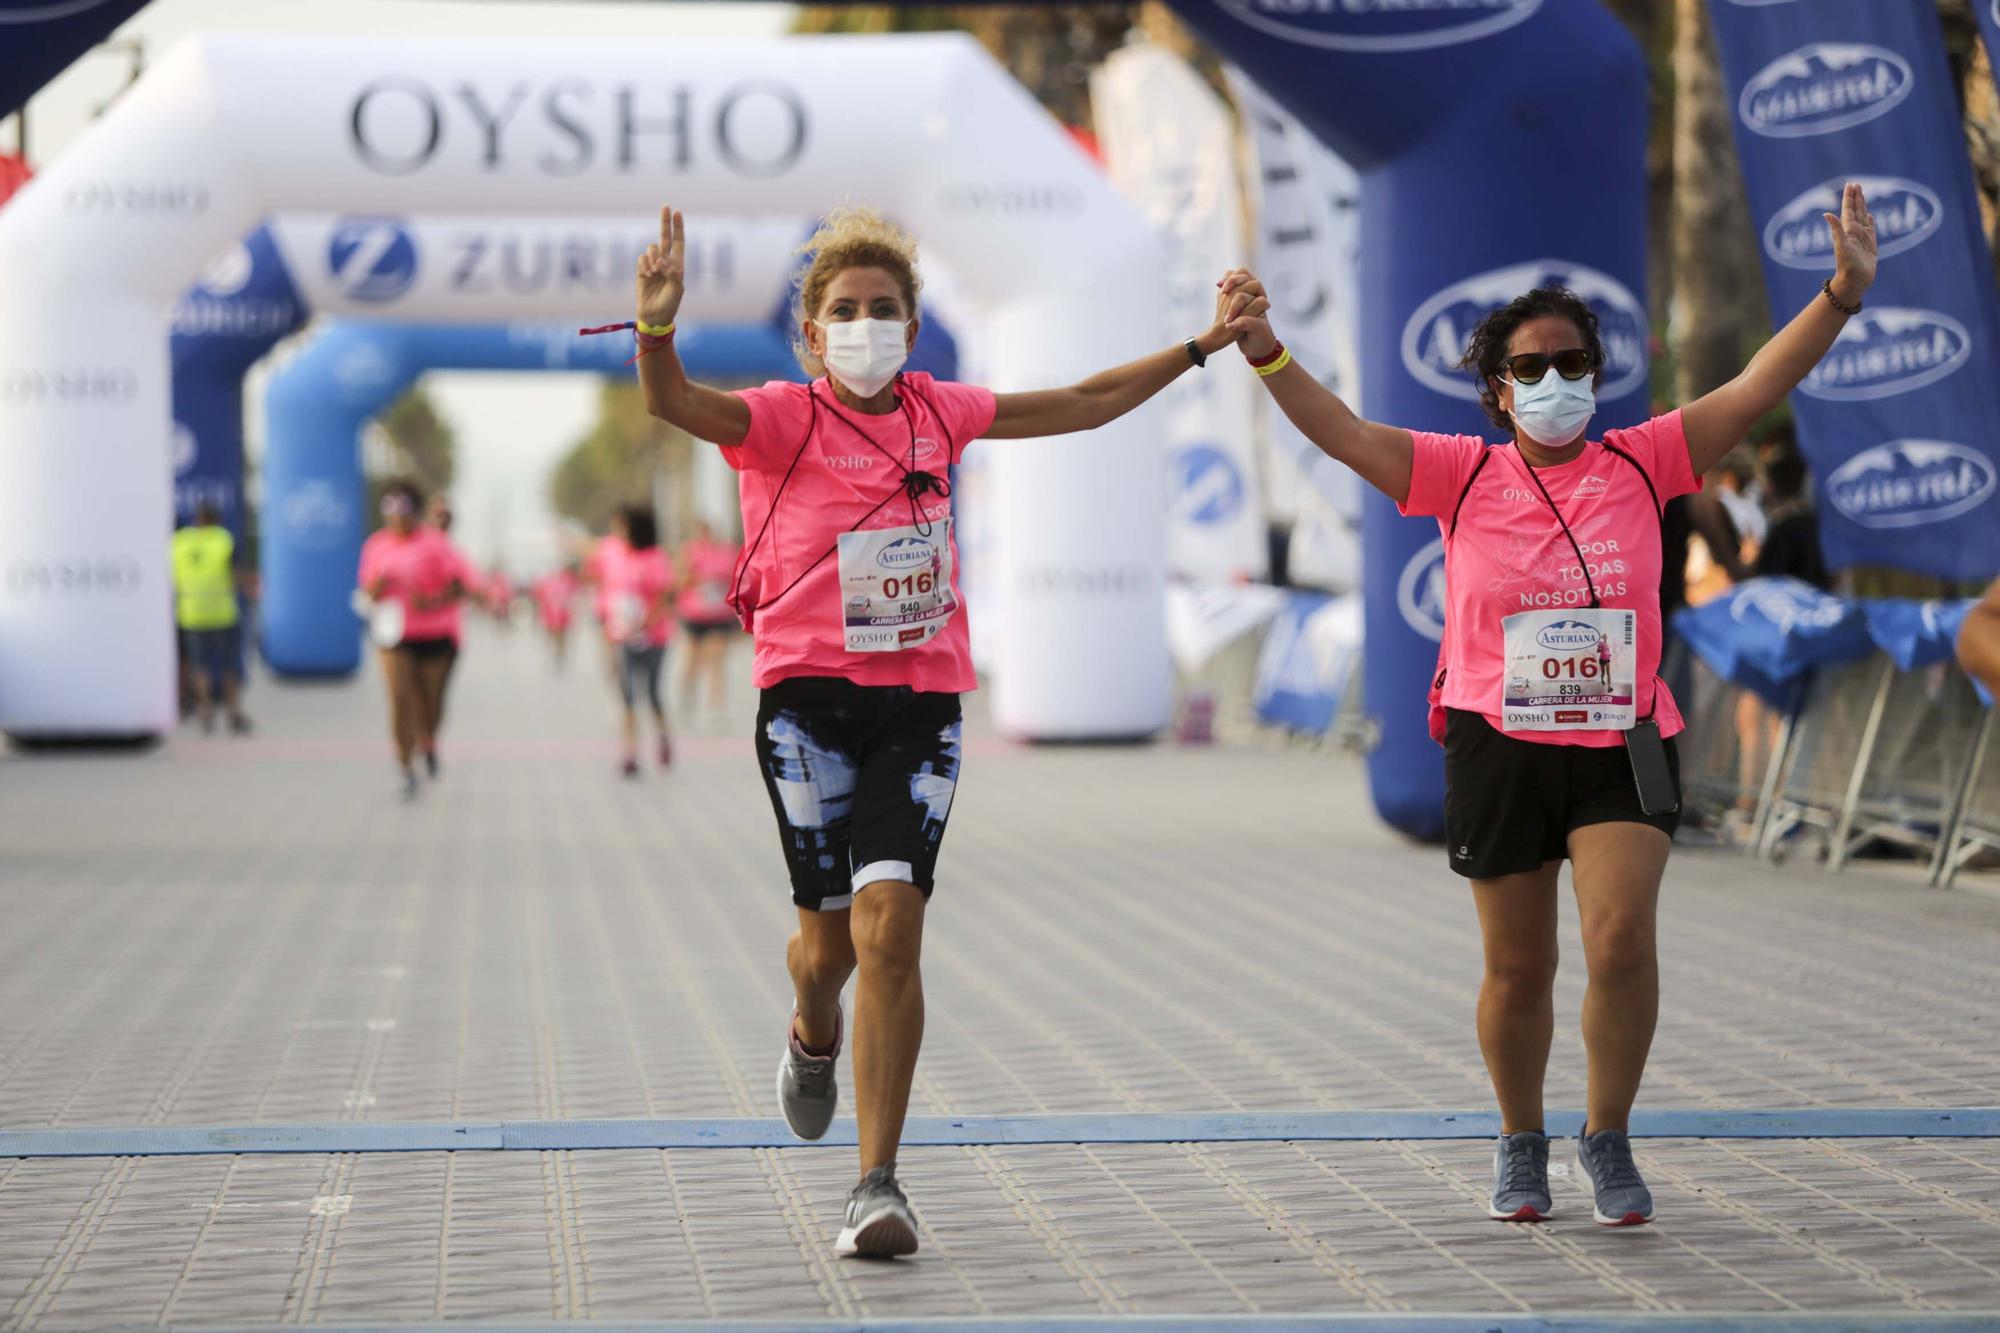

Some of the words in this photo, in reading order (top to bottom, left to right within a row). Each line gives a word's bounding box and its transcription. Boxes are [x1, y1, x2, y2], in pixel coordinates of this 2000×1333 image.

[349, 76, 811, 177] OYSHO
[449, 230, 738, 294] ZURIH
[881, 548, 931, 563] ASTURIANA
[1577, 540, 1620, 557] POR
[1558, 559, 1625, 581] TODAS
[882, 572, 932, 599] 016
[1520, 582, 1627, 607] NOSOTRAS
[900, 601, 920, 614] 840
[870, 615, 904, 626] CARRERA
[904, 613, 915, 623] DE
[915, 612, 925, 621] LA
[925, 607, 945, 619] MUJER
[850, 633, 893, 643] OYSHO
[1541, 632, 1596, 644] ASTURIANA
[1542, 657, 1598, 679] 016
[1559, 684, 1580, 695] 839
[1528, 696, 1563, 705] CARRERA
[1564, 696, 1575, 704] DE
[1576, 696, 1587, 704] LA
[1588, 695, 1613, 704] MUJER
[1508, 713, 1550, 723] OYSHO
